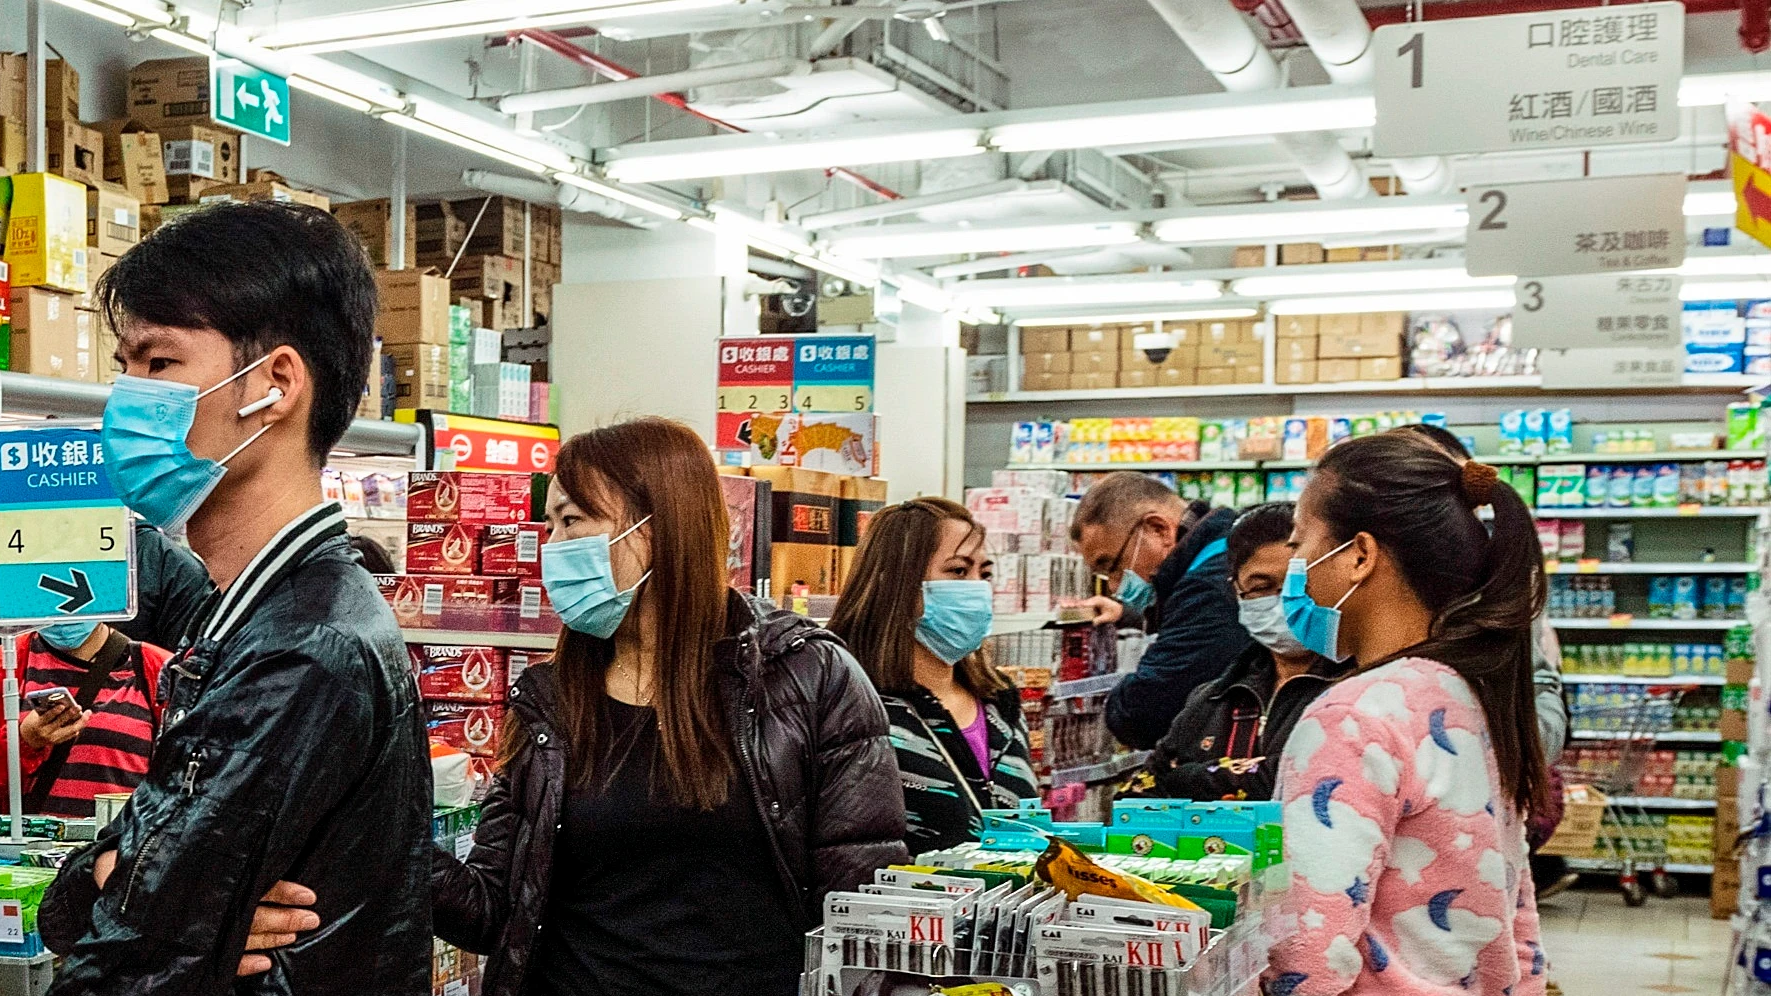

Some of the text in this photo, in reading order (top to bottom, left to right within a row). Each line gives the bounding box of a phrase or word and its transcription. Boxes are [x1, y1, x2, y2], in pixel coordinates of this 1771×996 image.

[1528, 13, 1658, 49] 口腔護理
[1397, 32, 1425, 89] 1
[1567, 49, 1659, 69] Dental Care
[1619, 120, 1659, 136] Wine
[1478, 189, 1509, 231] 2
[1523, 281, 1545, 312] 3
[738, 346, 790, 363] 收銀處
[818, 344, 869, 361] 收銀處
[735, 364, 776, 374] CASHIER
[814, 362, 856, 373] CASHIER
[718, 395, 865, 410] 1 2 3 4 5
[28, 471, 98, 488] CASHIER
[8, 529, 25, 553] 4
[100, 527, 115, 551] 5
[880, 873, 896, 883] KAI
[830, 904, 850, 914] KAI
[1076, 907, 1095, 917] KAI
[886, 929, 906, 941] KAI
[1041, 930, 1061, 938] KAI
[1103, 954, 1123, 964] KAI
